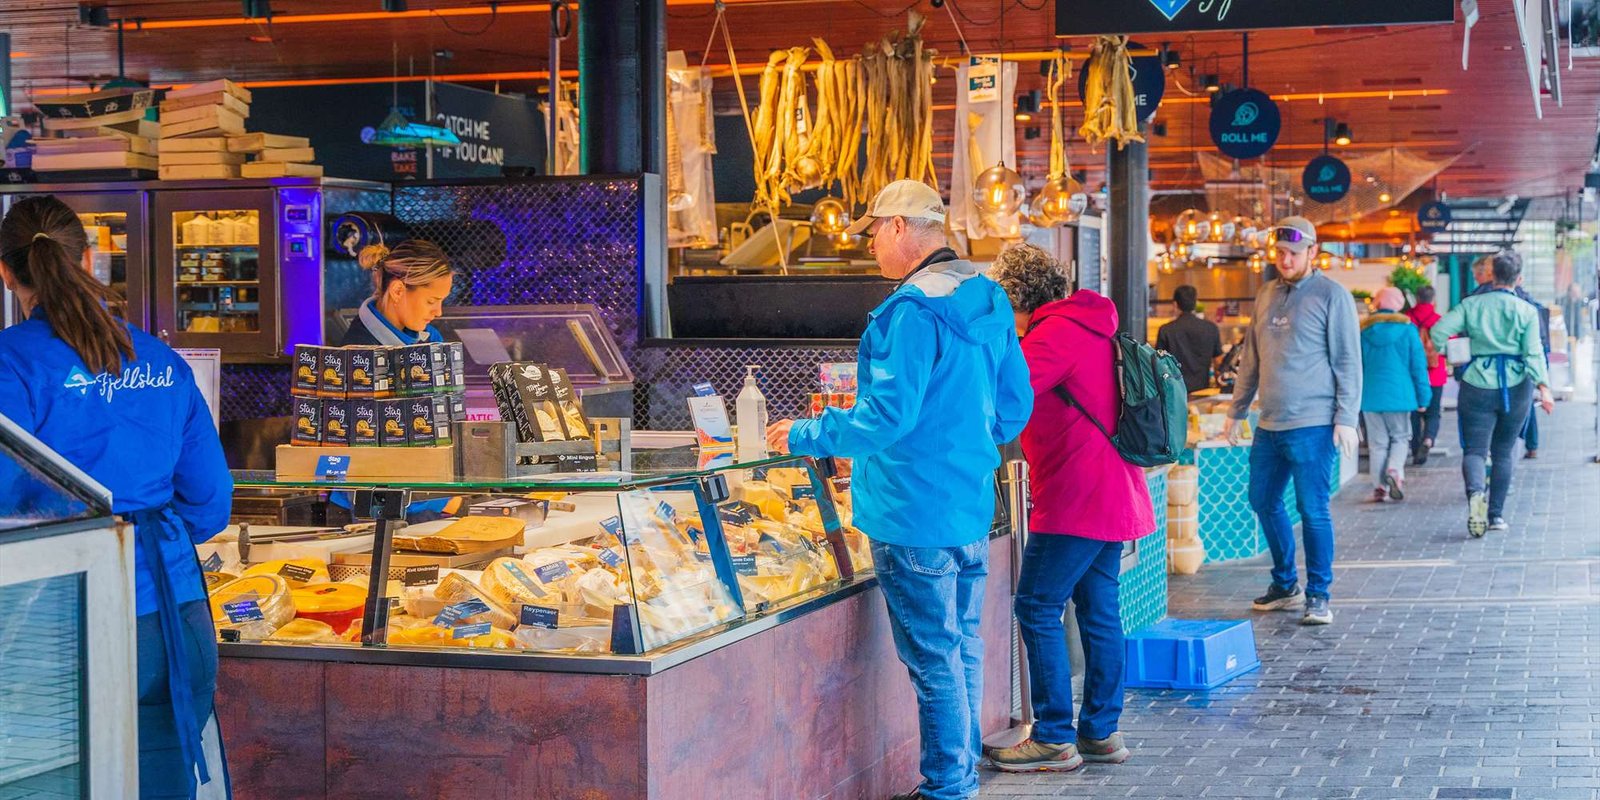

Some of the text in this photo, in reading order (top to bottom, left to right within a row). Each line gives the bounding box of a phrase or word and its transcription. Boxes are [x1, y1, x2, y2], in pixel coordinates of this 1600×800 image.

[474, 121, 490, 140] ME
[1221, 132, 1268, 143] ROLL ME
[391, 151, 417, 162] BAKE
[456, 142, 477, 162] YOU
[478, 145, 504, 166] CAN!
[1310, 184, 1342, 193] ROLL ME
[96, 362, 174, 403] Fjellskål
